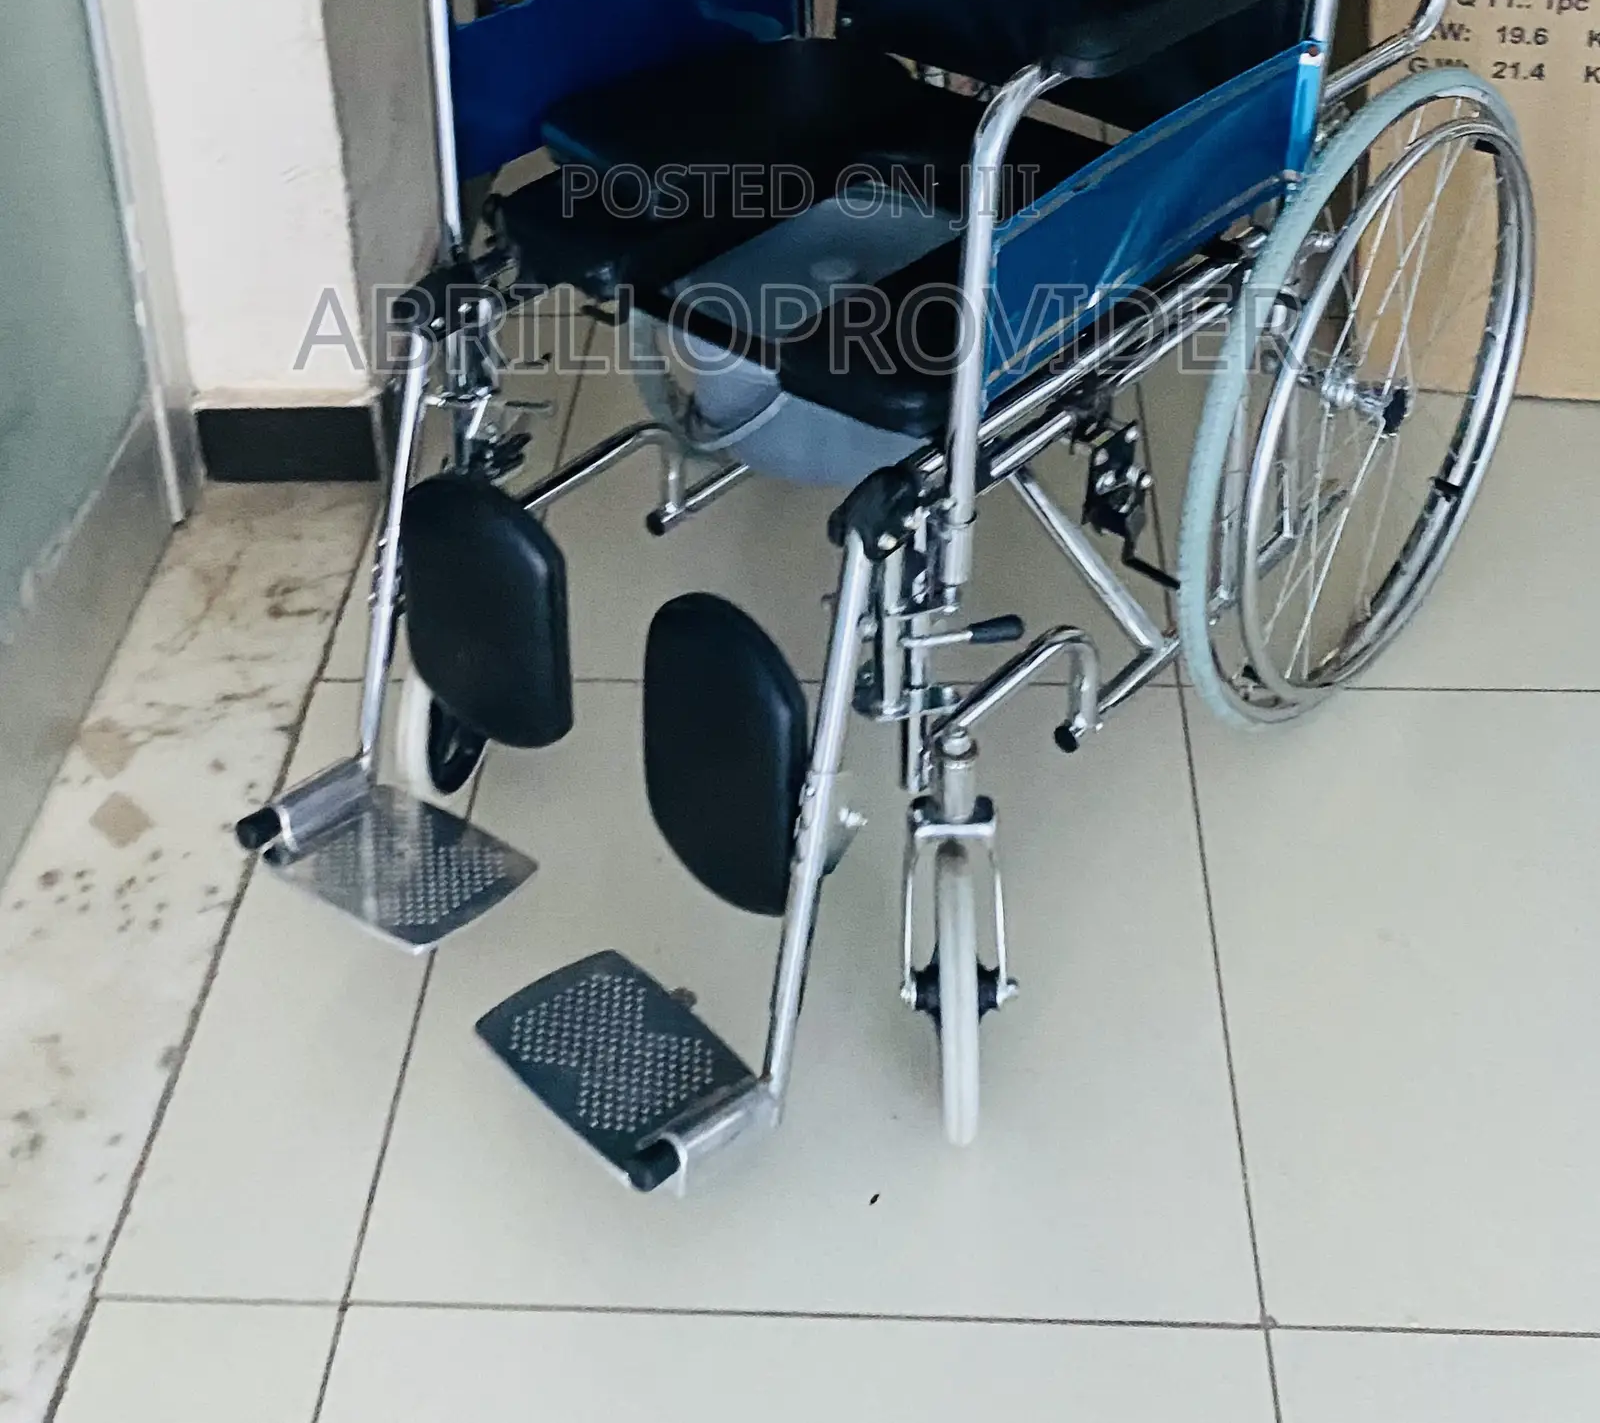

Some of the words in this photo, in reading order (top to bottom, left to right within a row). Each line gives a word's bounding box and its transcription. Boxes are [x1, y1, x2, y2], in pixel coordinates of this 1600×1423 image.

[1431, 22, 1471, 41] .W:
[1496, 26, 1549, 45] 19.6
[1492, 61, 1546, 81] 21.4
